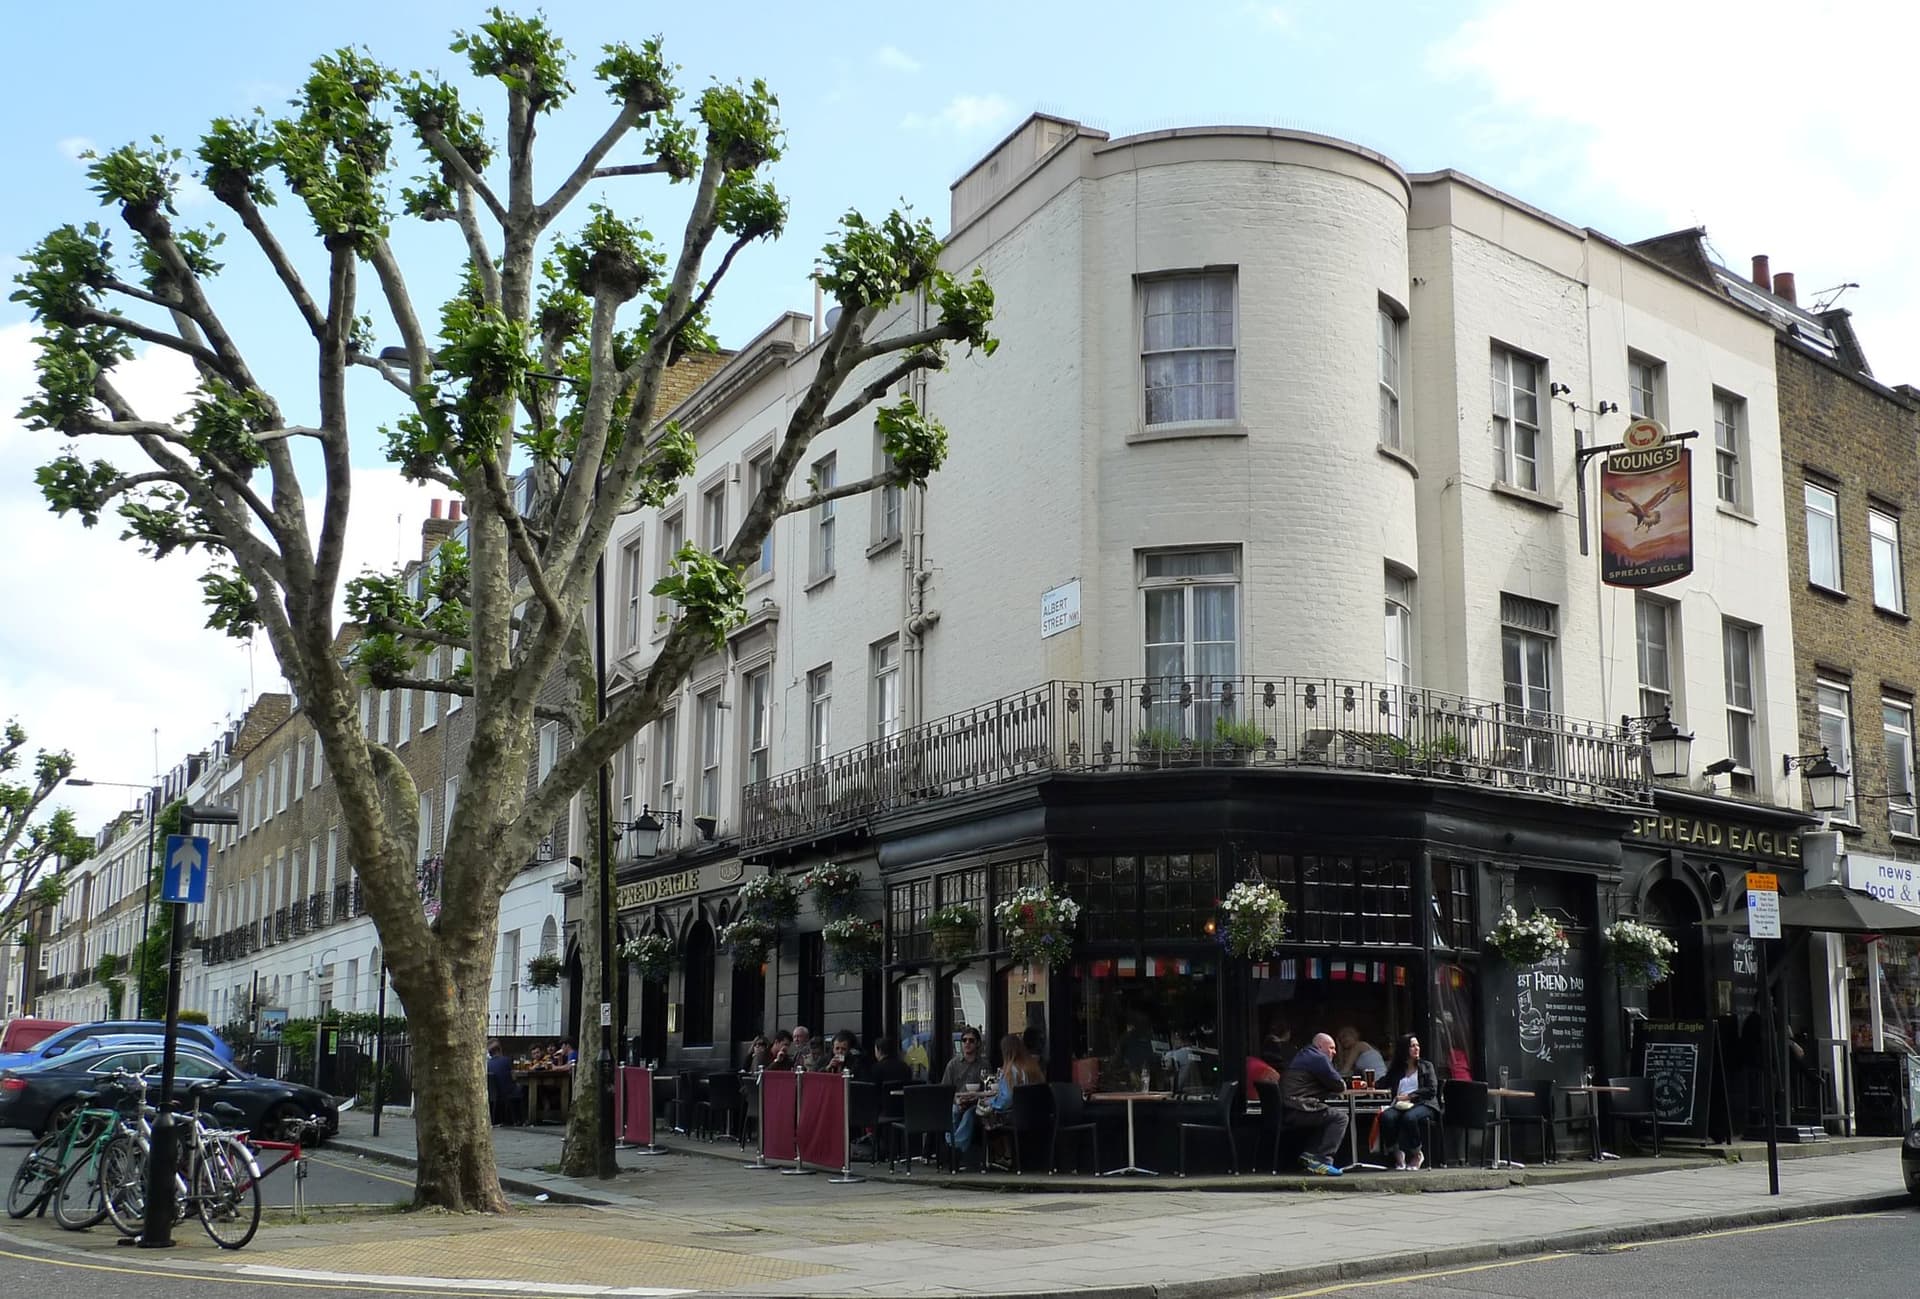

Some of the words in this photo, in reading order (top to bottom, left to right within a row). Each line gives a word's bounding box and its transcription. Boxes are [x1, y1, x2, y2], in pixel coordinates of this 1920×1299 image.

[1613, 448, 1674, 470] YOUNG'S
[1608, 567, 1648, 579] SPREAD
[1650, 563, 1684, 574] EAGLE
[1043, 597, 1068, 617] ALBERT
[1043, 613, 1068, 632] STREET
[1069, 611, 1079, 623] NW1
[1728, 827, 1800, 859] EAGLE
[1879, 864, 1912, 881] news
[658, 870, 700, 896] EAGLE
[1900, 884, 1912, 902] &
[1533, 970, 1568, 991] FRIEND
[1641, 1022, 1675, 1033] Spread
[1677, 1022, 1705, 1033] Eagle
